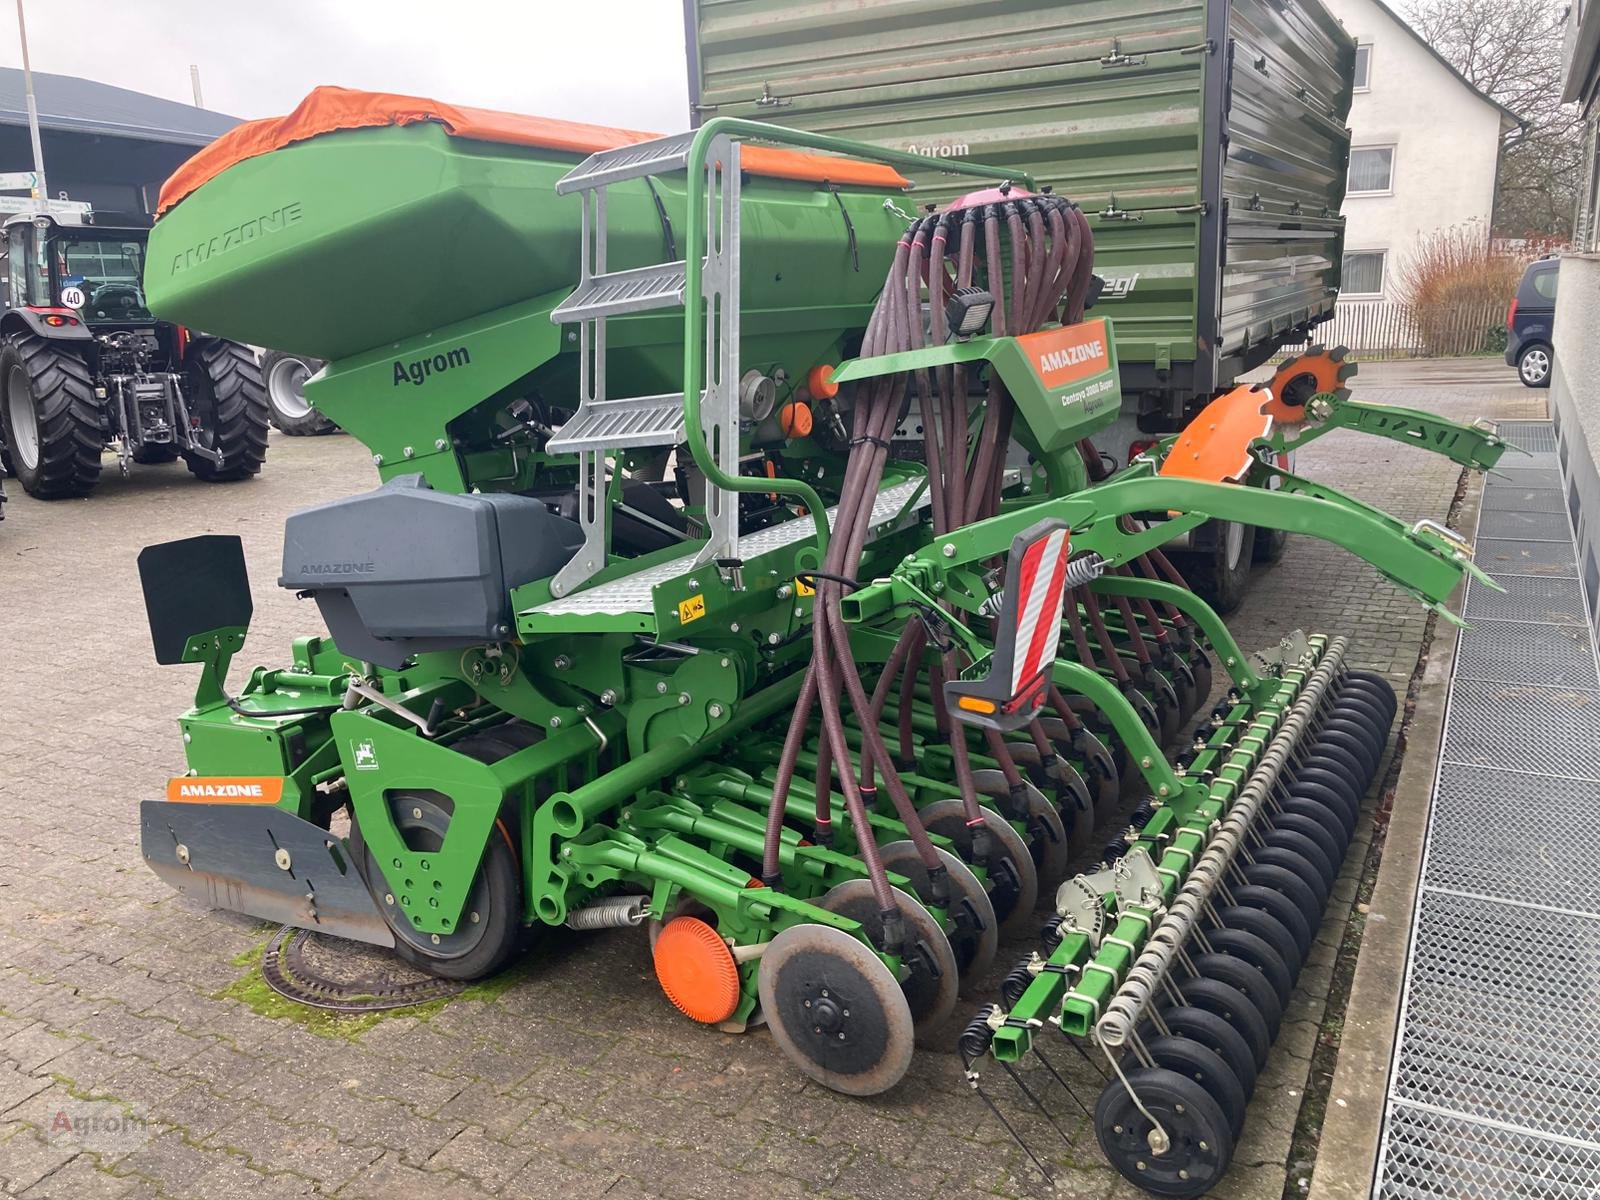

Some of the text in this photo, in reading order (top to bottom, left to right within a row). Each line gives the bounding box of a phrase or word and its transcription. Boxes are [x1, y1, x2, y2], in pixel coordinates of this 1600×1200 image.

[171, 201, 302, 276] AMAZONE
[1100, 273, 1140, 296] egl
[66, 291, 80, 305] 40
[393, 347, 471, 386] Agrom
[1040, 340, 1104, 373] AMAZONE
[301, 562, 375, 575] AMAZONE
[180, 784, 263, 797] AMAZONE
